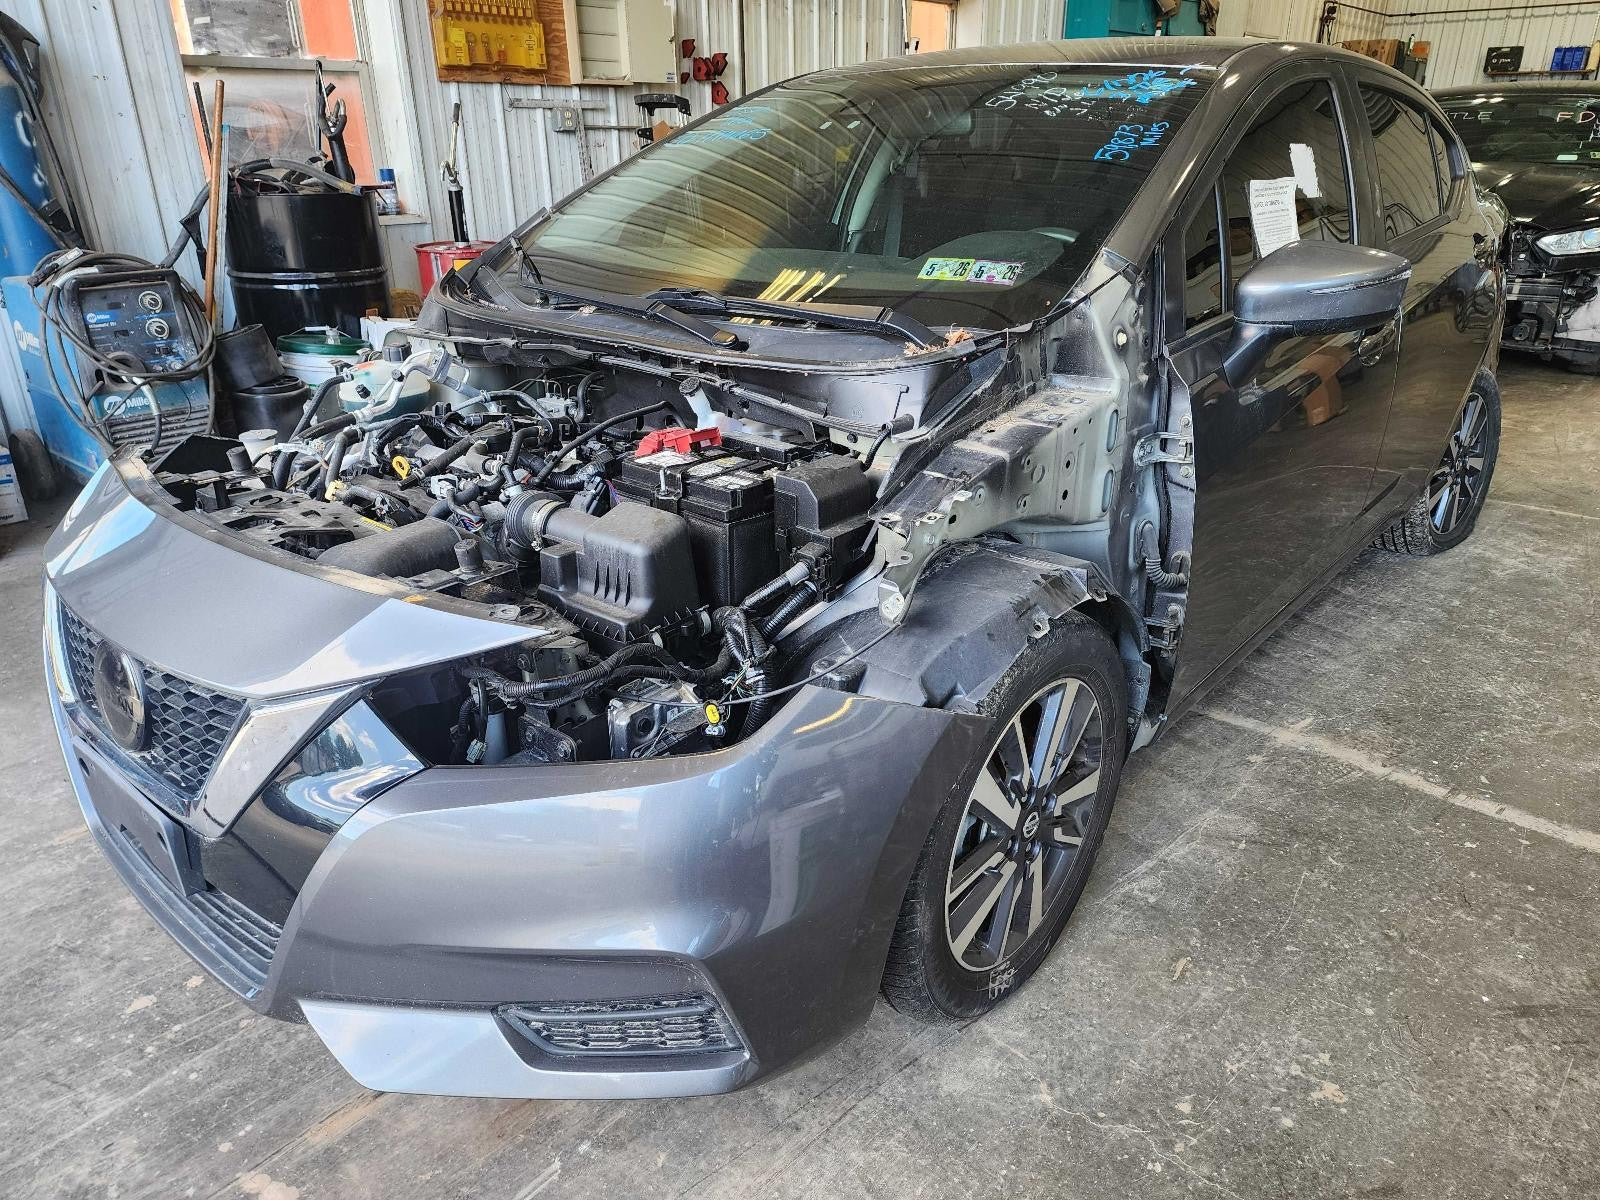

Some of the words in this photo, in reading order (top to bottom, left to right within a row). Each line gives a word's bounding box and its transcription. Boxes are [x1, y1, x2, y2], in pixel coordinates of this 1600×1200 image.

[925, 263, 938, 276] 5
[953, 261, 970, 276] 26
[1002, 265, 1019, 280] 26
[126, 397, 150, 408] Mille
